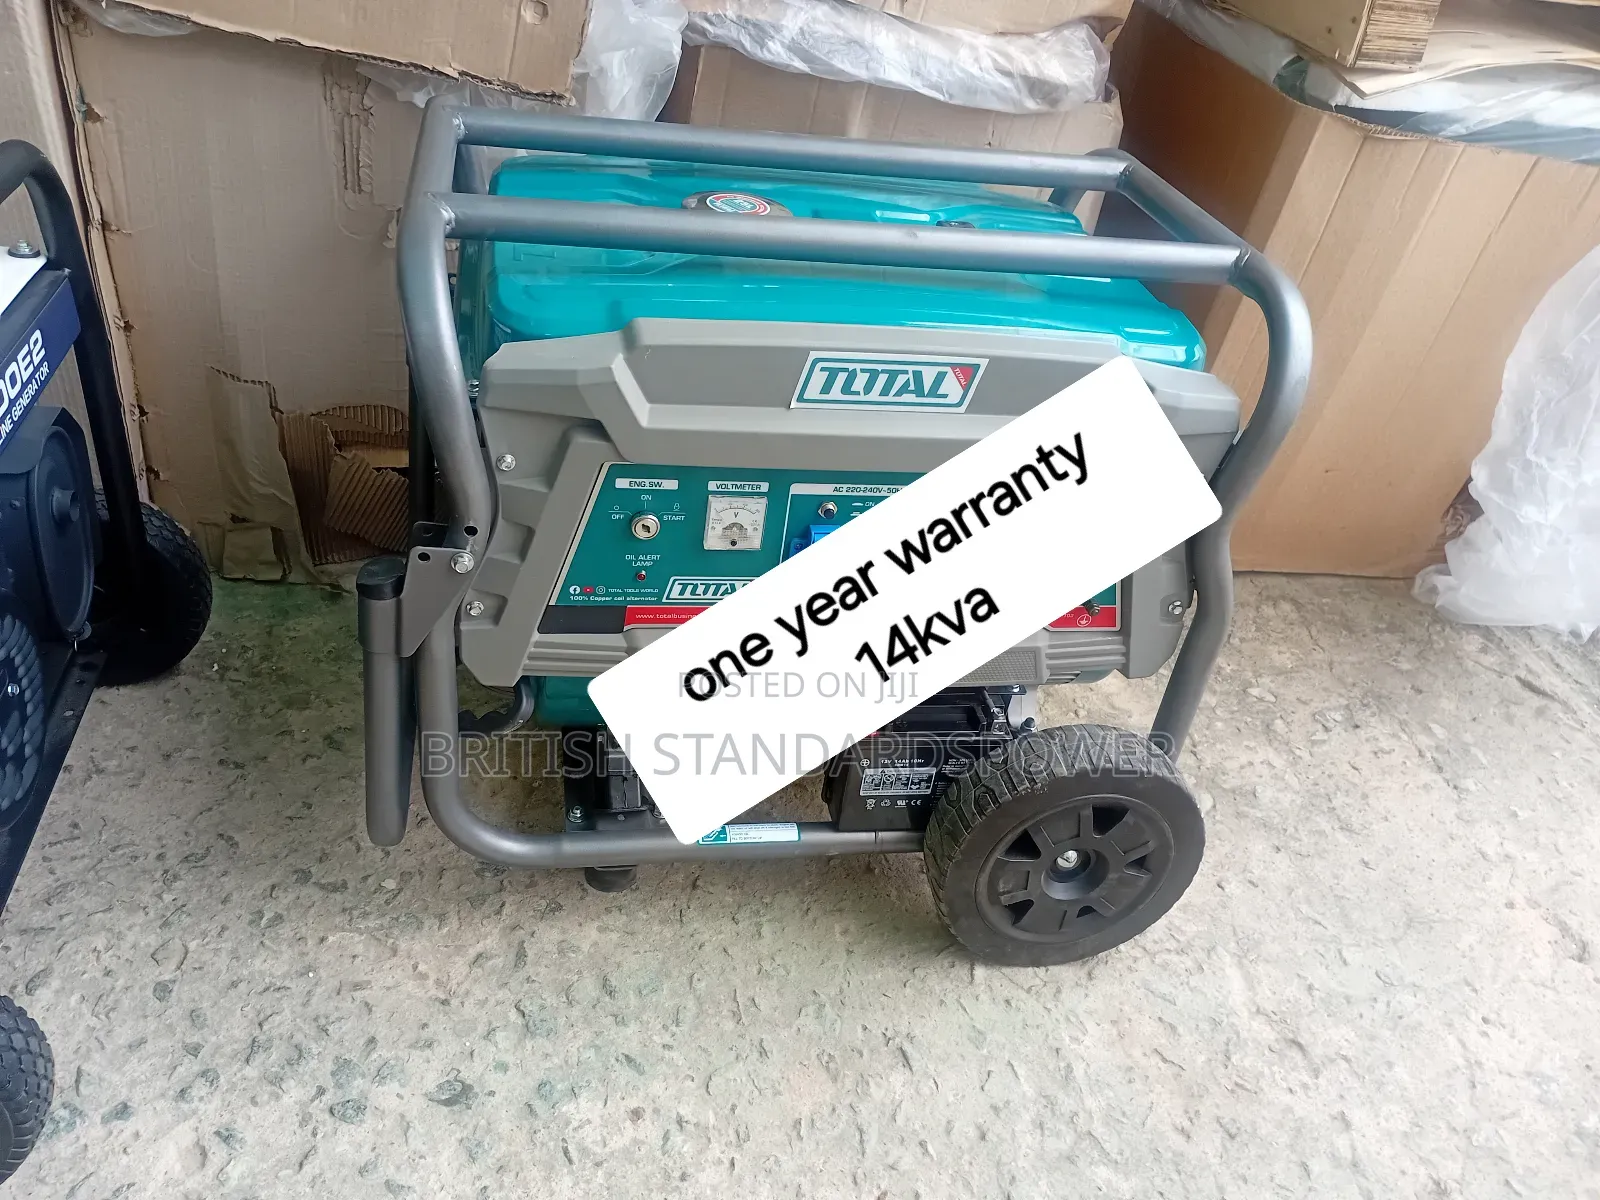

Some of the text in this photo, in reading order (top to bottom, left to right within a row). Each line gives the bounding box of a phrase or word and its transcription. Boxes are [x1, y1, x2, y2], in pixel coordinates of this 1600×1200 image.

[819, 366, 949, 399] TOTAL
[954, 367, 967, 387] TOTAL
[11, 361, 50, 422] GENERATOR
[678, 583, 749, 597] TOTA
